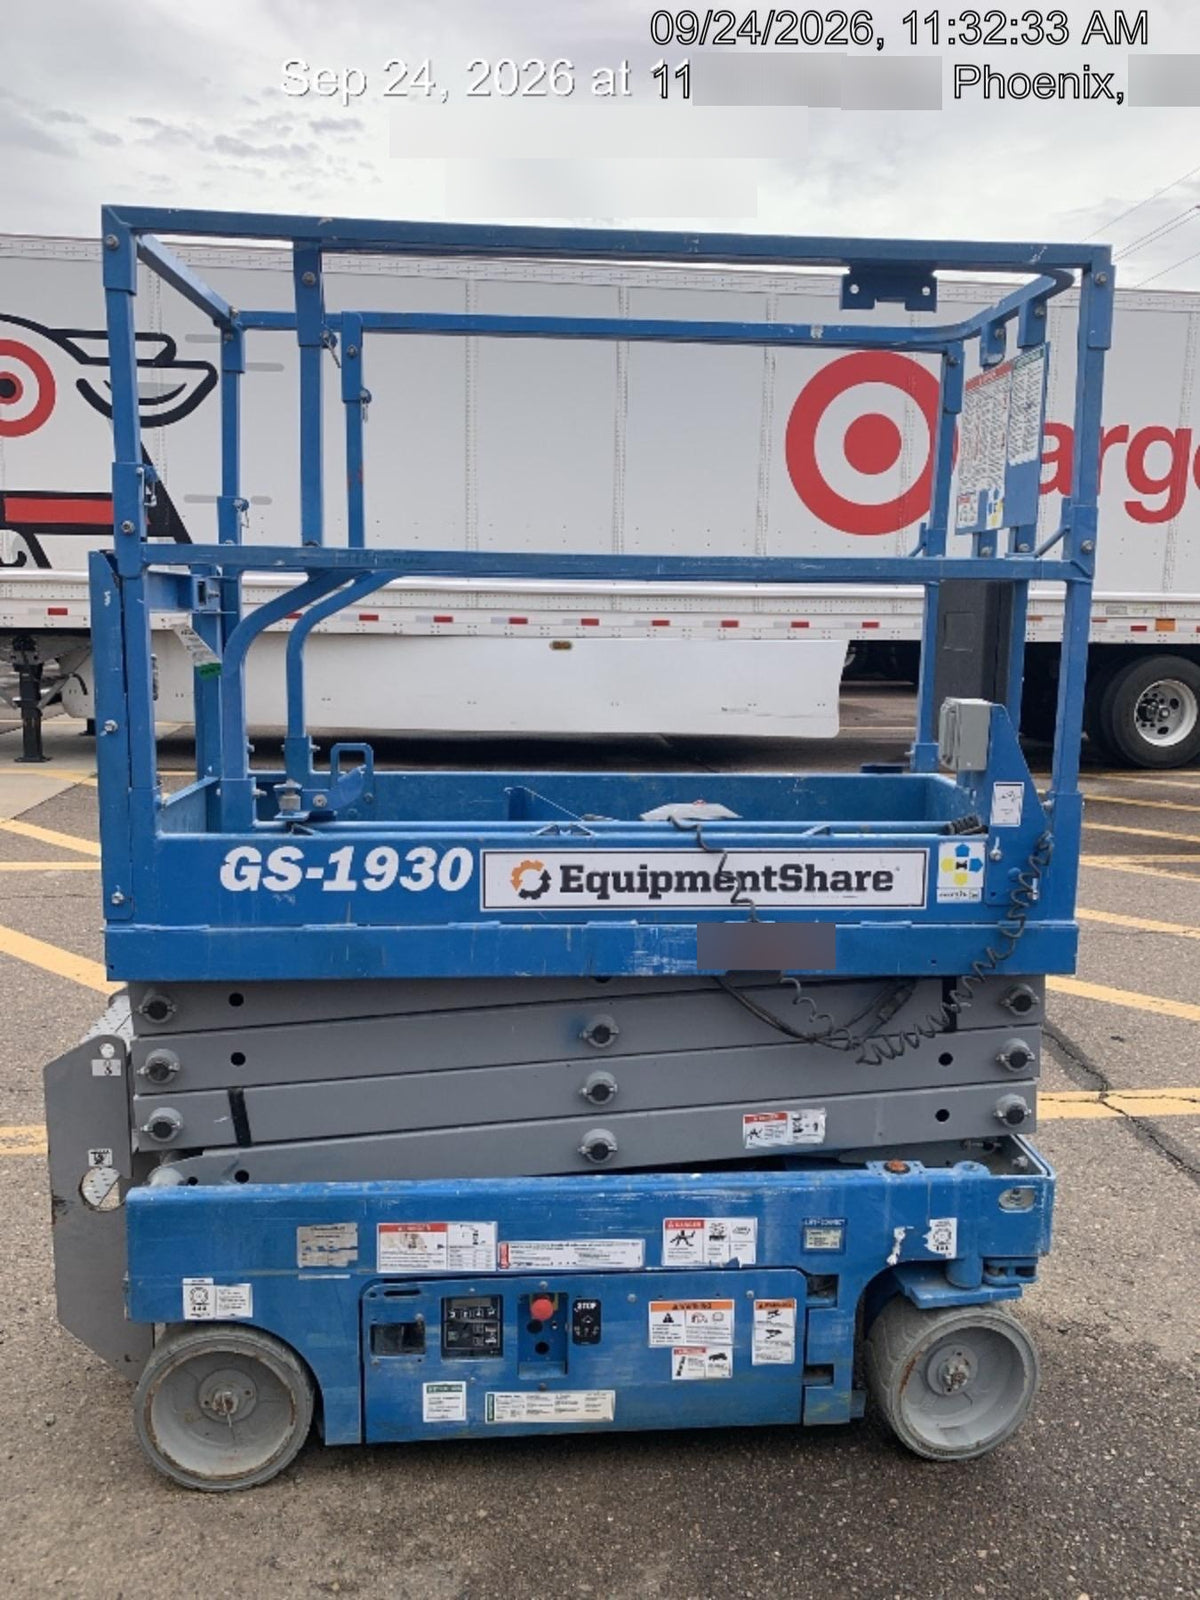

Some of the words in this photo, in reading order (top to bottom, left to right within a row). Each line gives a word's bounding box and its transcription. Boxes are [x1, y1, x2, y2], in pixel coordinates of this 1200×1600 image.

[1040, 422, 1200, 524] arg
[219, 845, 474, 892] GS-1930
[559, 863, 894, 900] EquipmentShare
